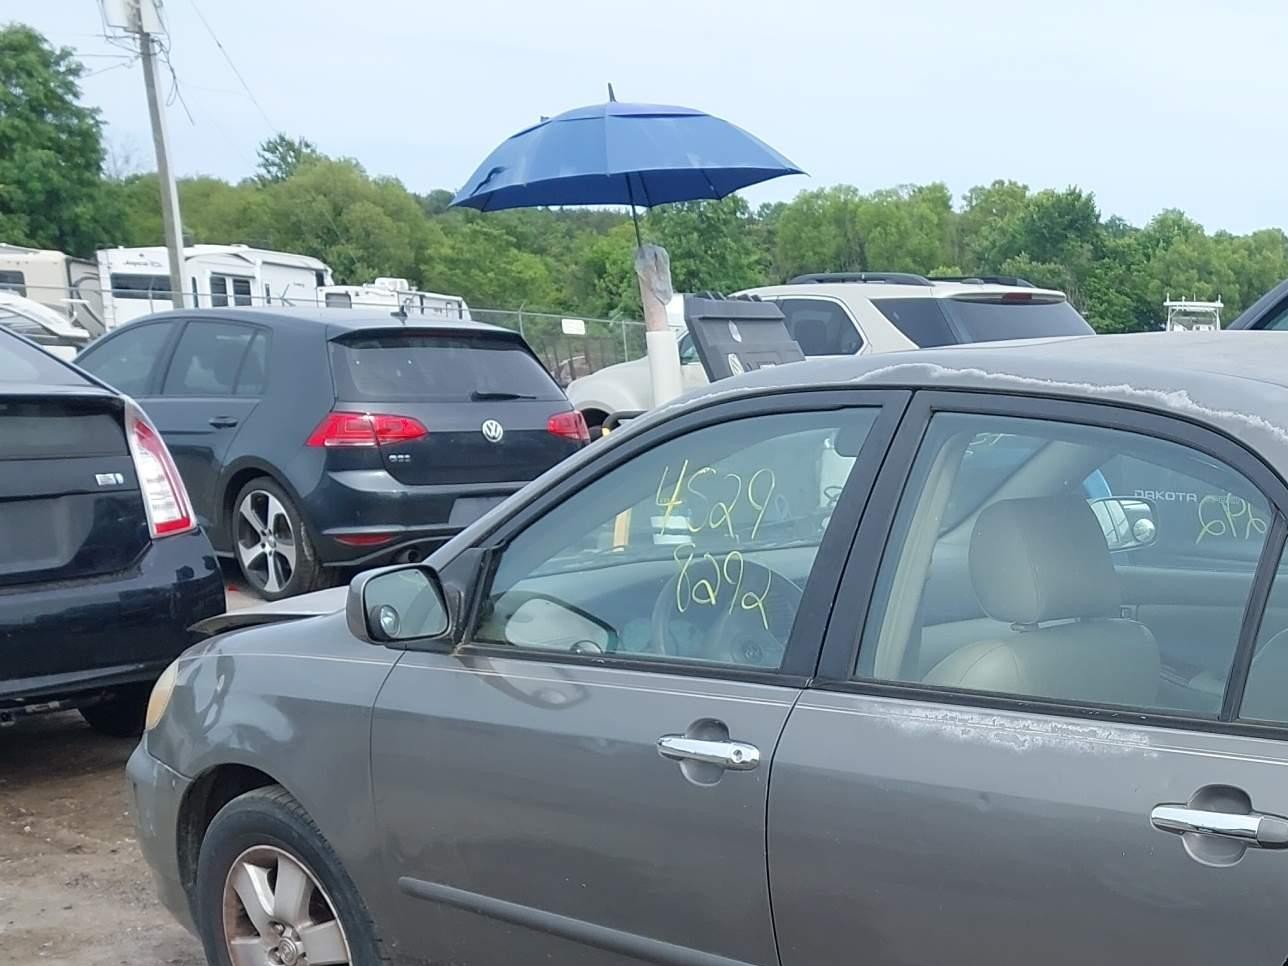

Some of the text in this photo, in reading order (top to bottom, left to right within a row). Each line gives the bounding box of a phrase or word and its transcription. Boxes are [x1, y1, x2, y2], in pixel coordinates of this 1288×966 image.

[655, 459, 775, 540] 4529
[1133, 489, 1198, 502] DAKOTA
[673, 542, 773, 631] 8292
